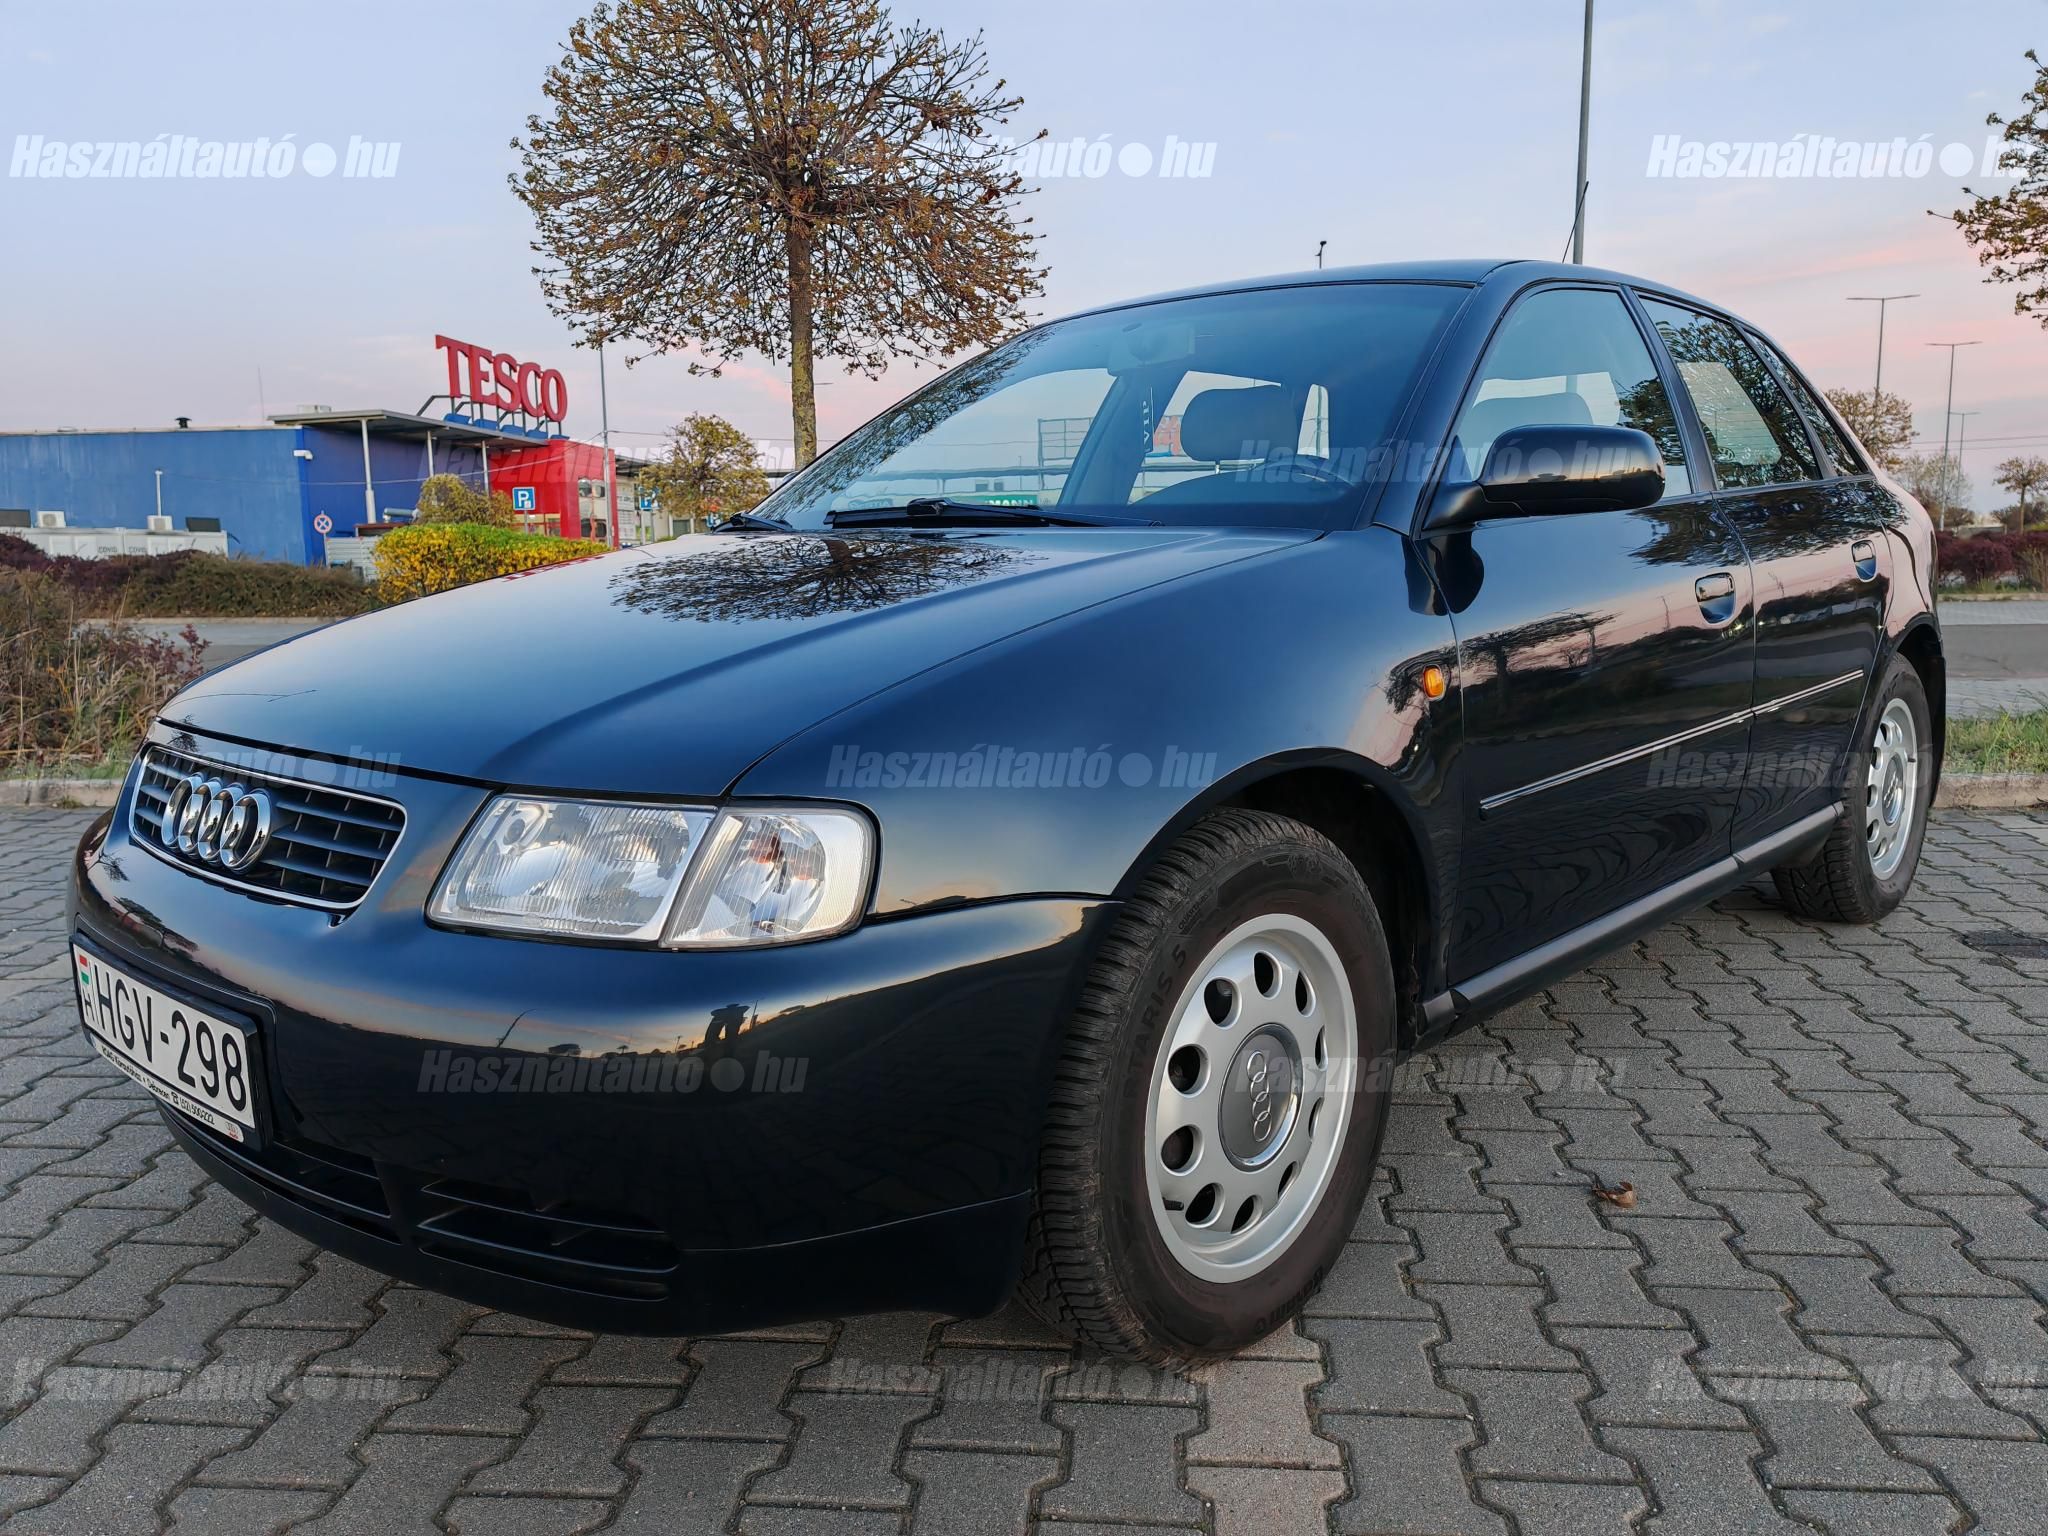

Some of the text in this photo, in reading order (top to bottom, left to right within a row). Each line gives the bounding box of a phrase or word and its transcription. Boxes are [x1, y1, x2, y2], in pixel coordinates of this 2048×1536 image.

[435, 334, 568, 422] TESCO
[518, 490, 530, 507] P
[94, 964, 247, 1112] HGV-298
